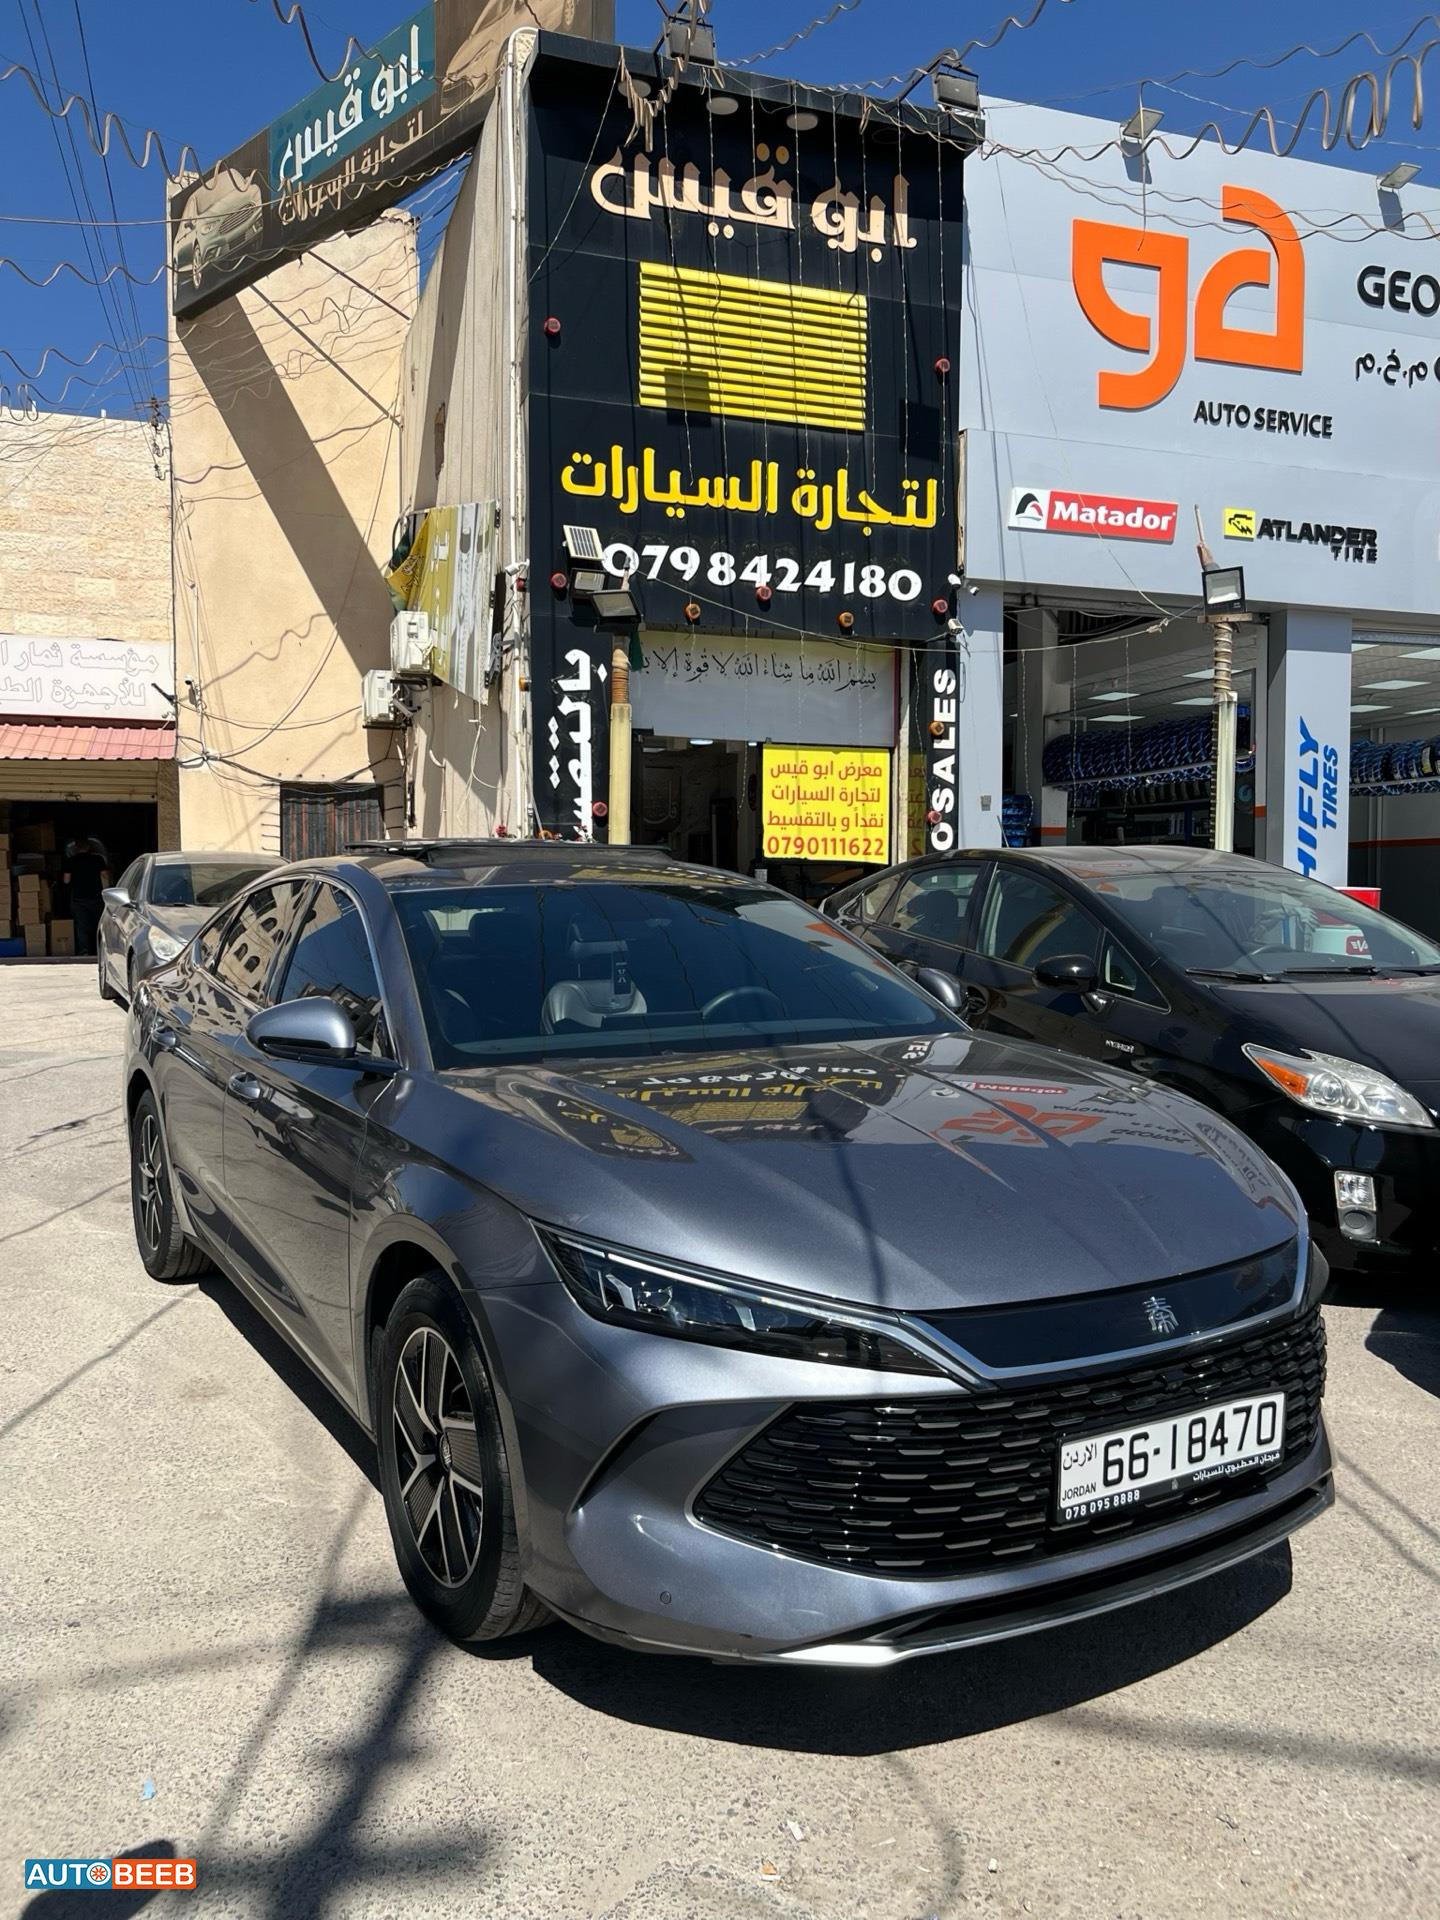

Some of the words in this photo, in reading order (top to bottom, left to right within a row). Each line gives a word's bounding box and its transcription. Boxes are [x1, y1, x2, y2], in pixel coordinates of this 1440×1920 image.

[371, 24, 424, 119] ابو
[279, 67, 363, 183] قيس
[361, 110, 423, 176] لتجارة
[279, 156, 355, 225] السيارات
[590, 142, 796, 240] قيس
[811, 174, 917, 263] ابو
[1193, 400, 1251, 428] AUTO
[1253, 408, 1333, 439] SERVICE
[561, 444, 779, 519] السيارات
[792, 468, 938, 536] لتجارة
[1052, 500, 1174, 531] Matador
[1256, 518, 1378, 548] ATLANDER
[1330, 546, 1378, 564] TIRE
[601, 542, 922, 601] 0798424180
[14, 641, 63, 671] ثمار
[70, 643, 159, 677] مؤسسة
[684, 648, 709, 682] قوة
[712, 651, 735, 677] لا
[735, 652, 758, 679] الله
[763, 652, 793, 684] شاء
[799, 654, 815, 686] ما
[817, 659, 840, 684] الله
[834, 662, 877, 692] بسم
[51, 677, 145, 710] للأجهزة
[771, 760, 808, 779] قيس
[813, 761, 833, 779] ابو
[839, 762, 882, 781] معرض
[771, 785, 834, 805] السيارات
[839, 787, 881, 806] لتجارة
[1322, 745, 1339, 829] TIRES
[767, 810, 837, 831] بالتقسيط
[841, 816, 850, 832] و
[767, 836, 884, 856] 0790111622
[1062, 1442, 1098, 1471] الاردن
[1102, 1401, 1277, 1488] 66-18470
[1062, 1482, 1097, 1502] JORDAN
[1065, 1504, 1087, 1521] 078
[1089, 1497, 1110, 1514] 095
[1112, 1489, 1141, 1507] 8888
